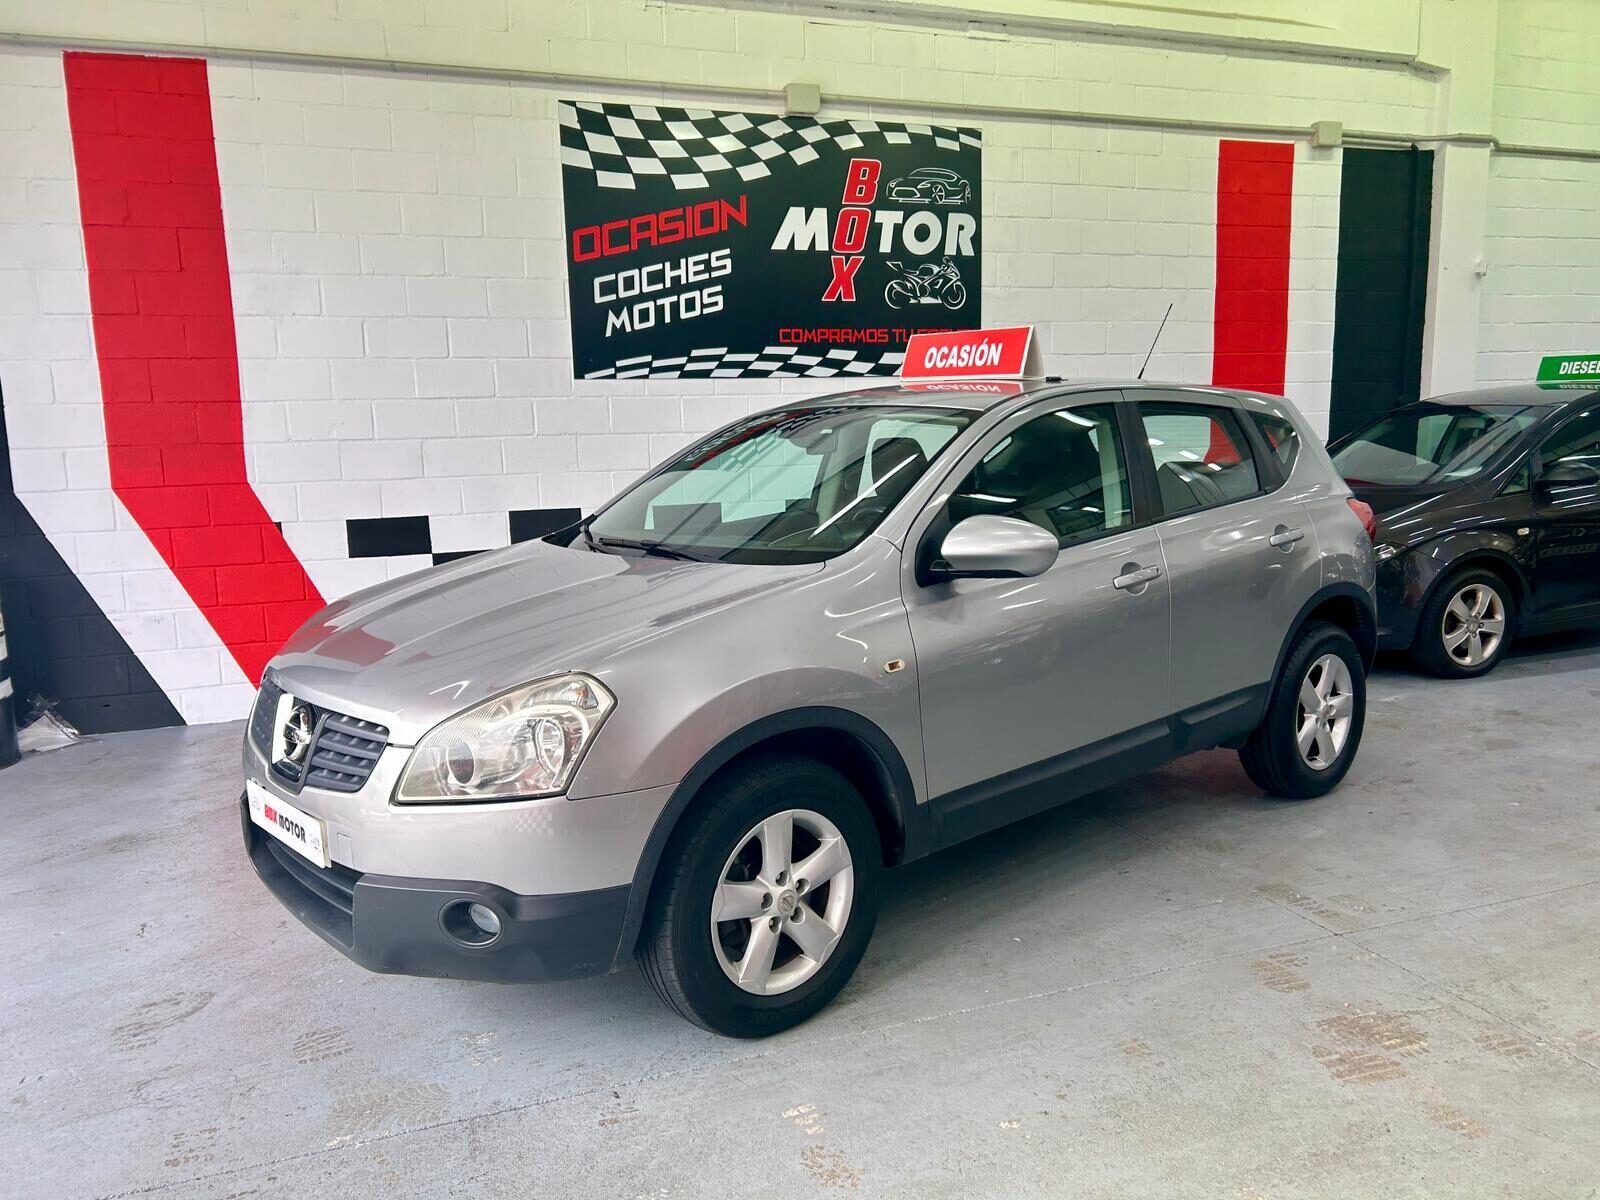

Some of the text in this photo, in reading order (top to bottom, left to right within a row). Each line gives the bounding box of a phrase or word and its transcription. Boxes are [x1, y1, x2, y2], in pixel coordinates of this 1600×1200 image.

[572, 194, 748, 263] OCASION
[770, 206, 977, 257] MOTOR
[824, 158, 882, 302] BOX
[593, 247, 732, 304] COCHES
[605, 284, 724, 338] MOTOS
[779, 328, 889, 344] COMPRAMOS
[923, 337, 1003, 369] OCASIÓN
[278, 813, 306, 843] MOTOR
